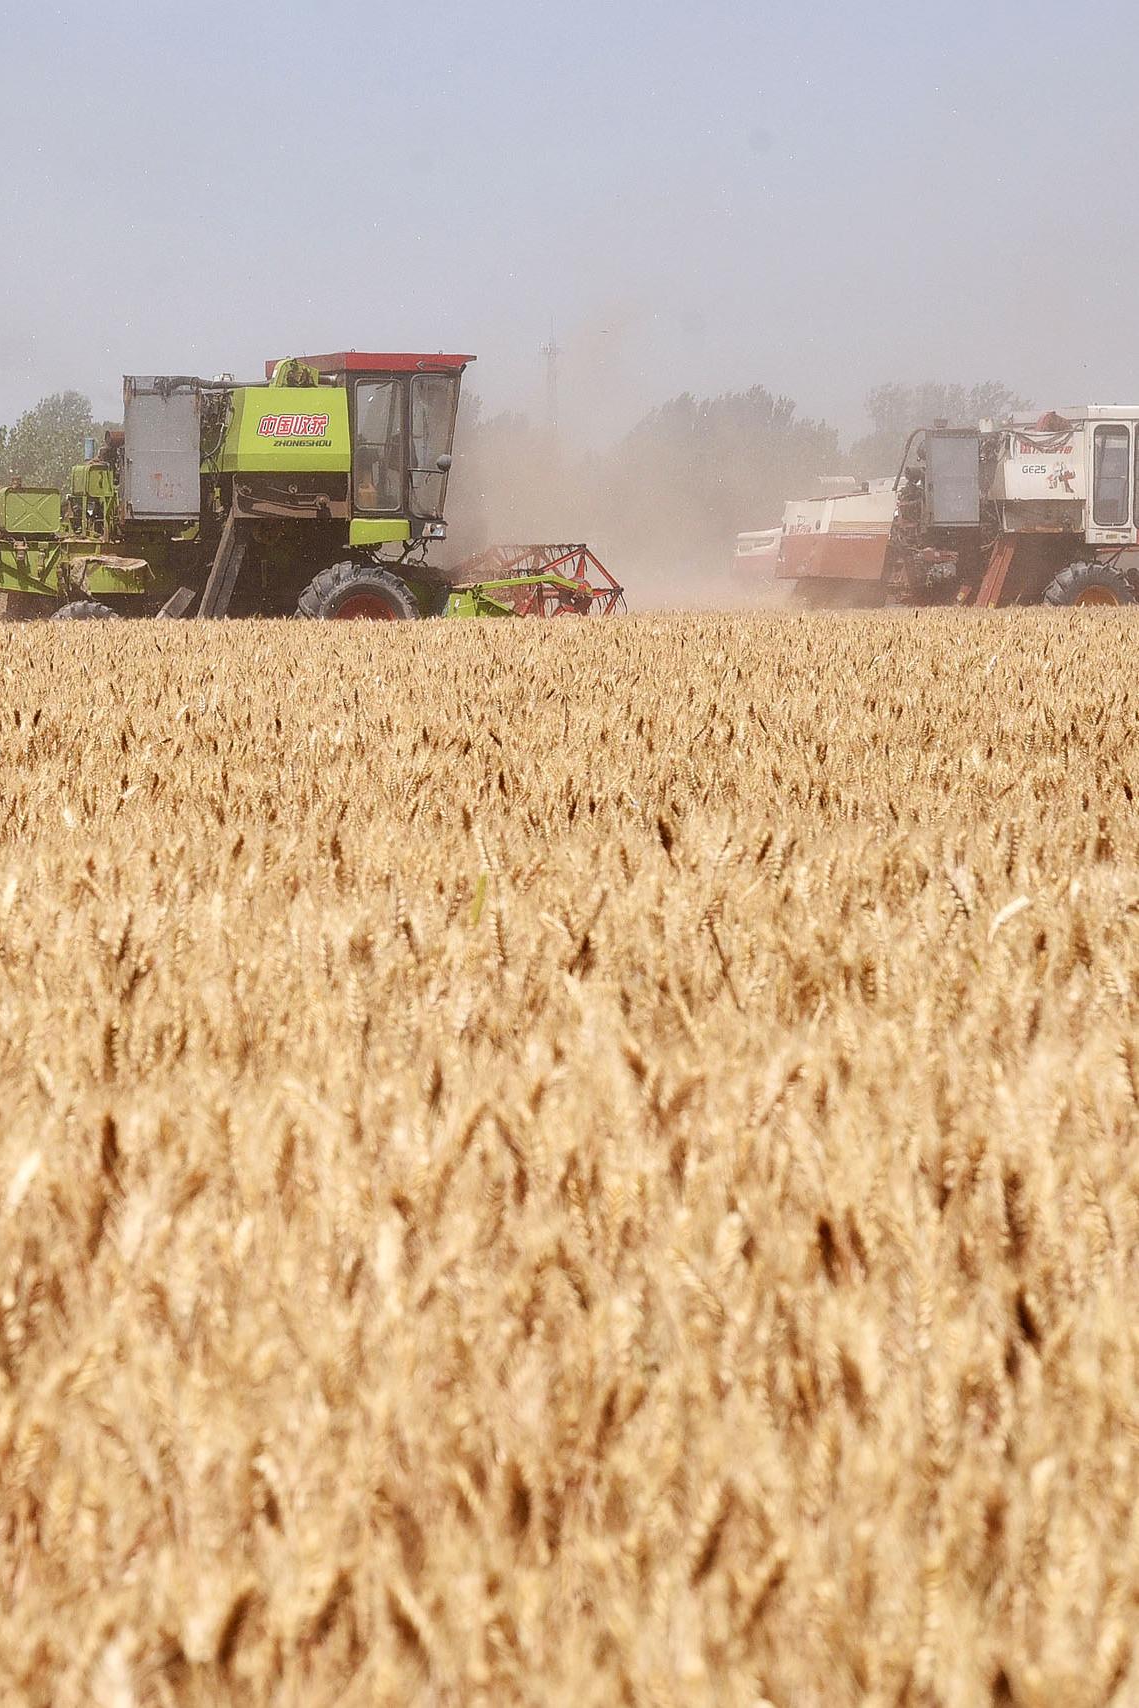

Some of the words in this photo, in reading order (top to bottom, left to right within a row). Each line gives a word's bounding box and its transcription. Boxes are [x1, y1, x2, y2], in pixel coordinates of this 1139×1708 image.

[258, 415, 328, 436] 中国收获
[273, 439, 333, 447] ZHONGSHOU
[1021, 465, 1047, 474] GE25
